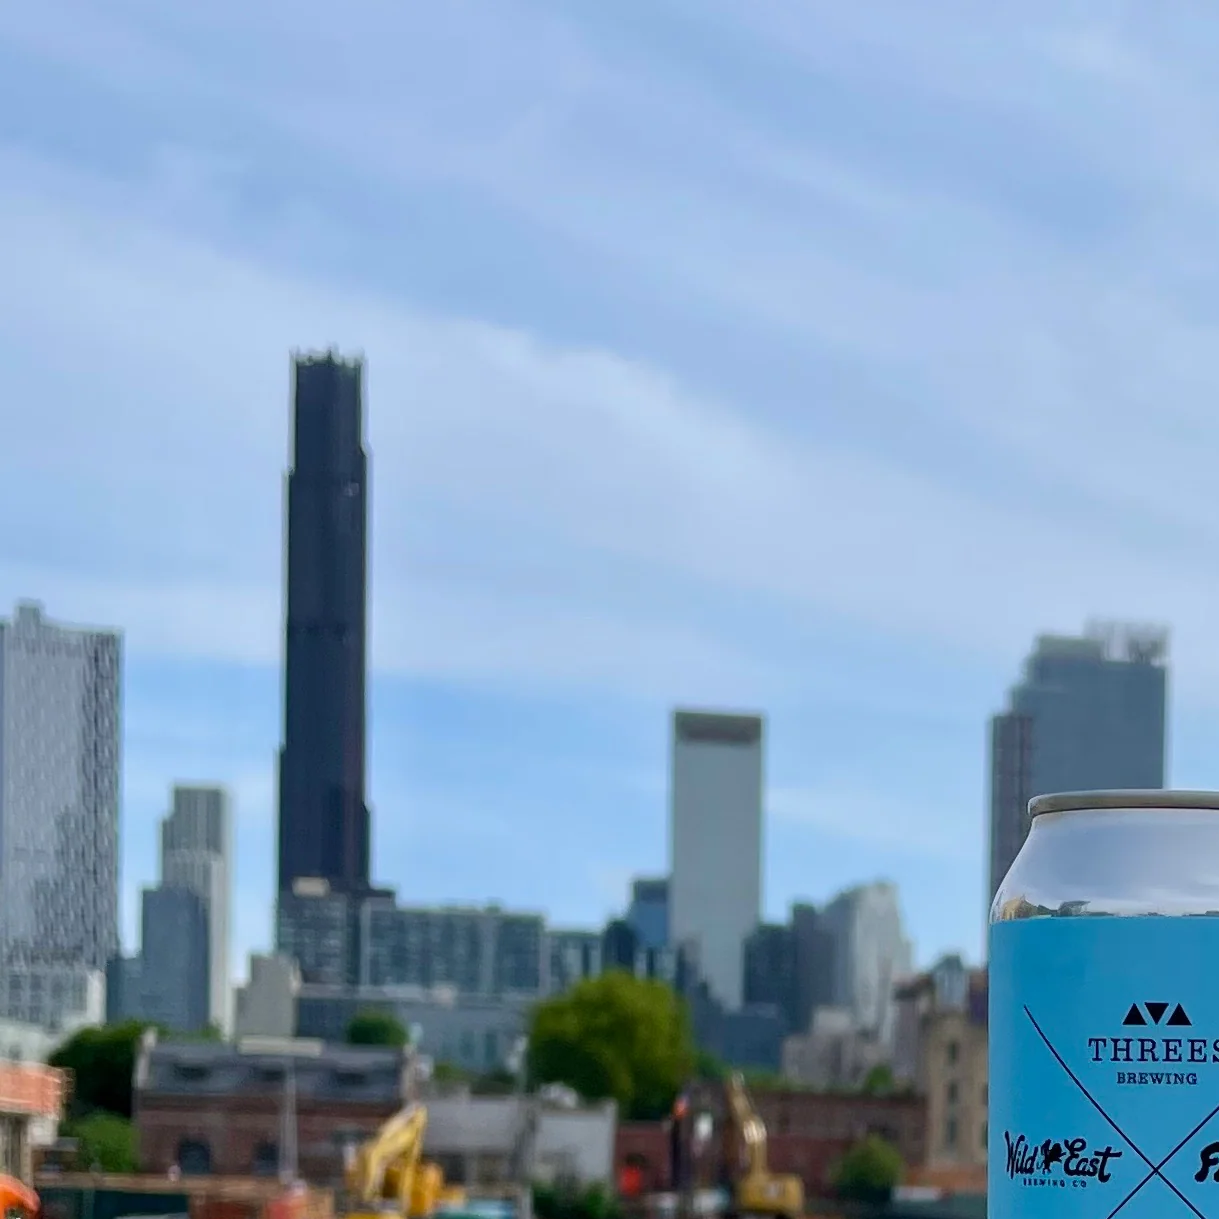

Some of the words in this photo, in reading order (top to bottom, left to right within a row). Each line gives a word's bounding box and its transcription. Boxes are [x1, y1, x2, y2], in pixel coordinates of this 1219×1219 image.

[1116, 1071, 1198, 1085] BREWING
[1004, 1130, 1039, 1180] Wild
[1063, 1137, 1123, 1183] East
